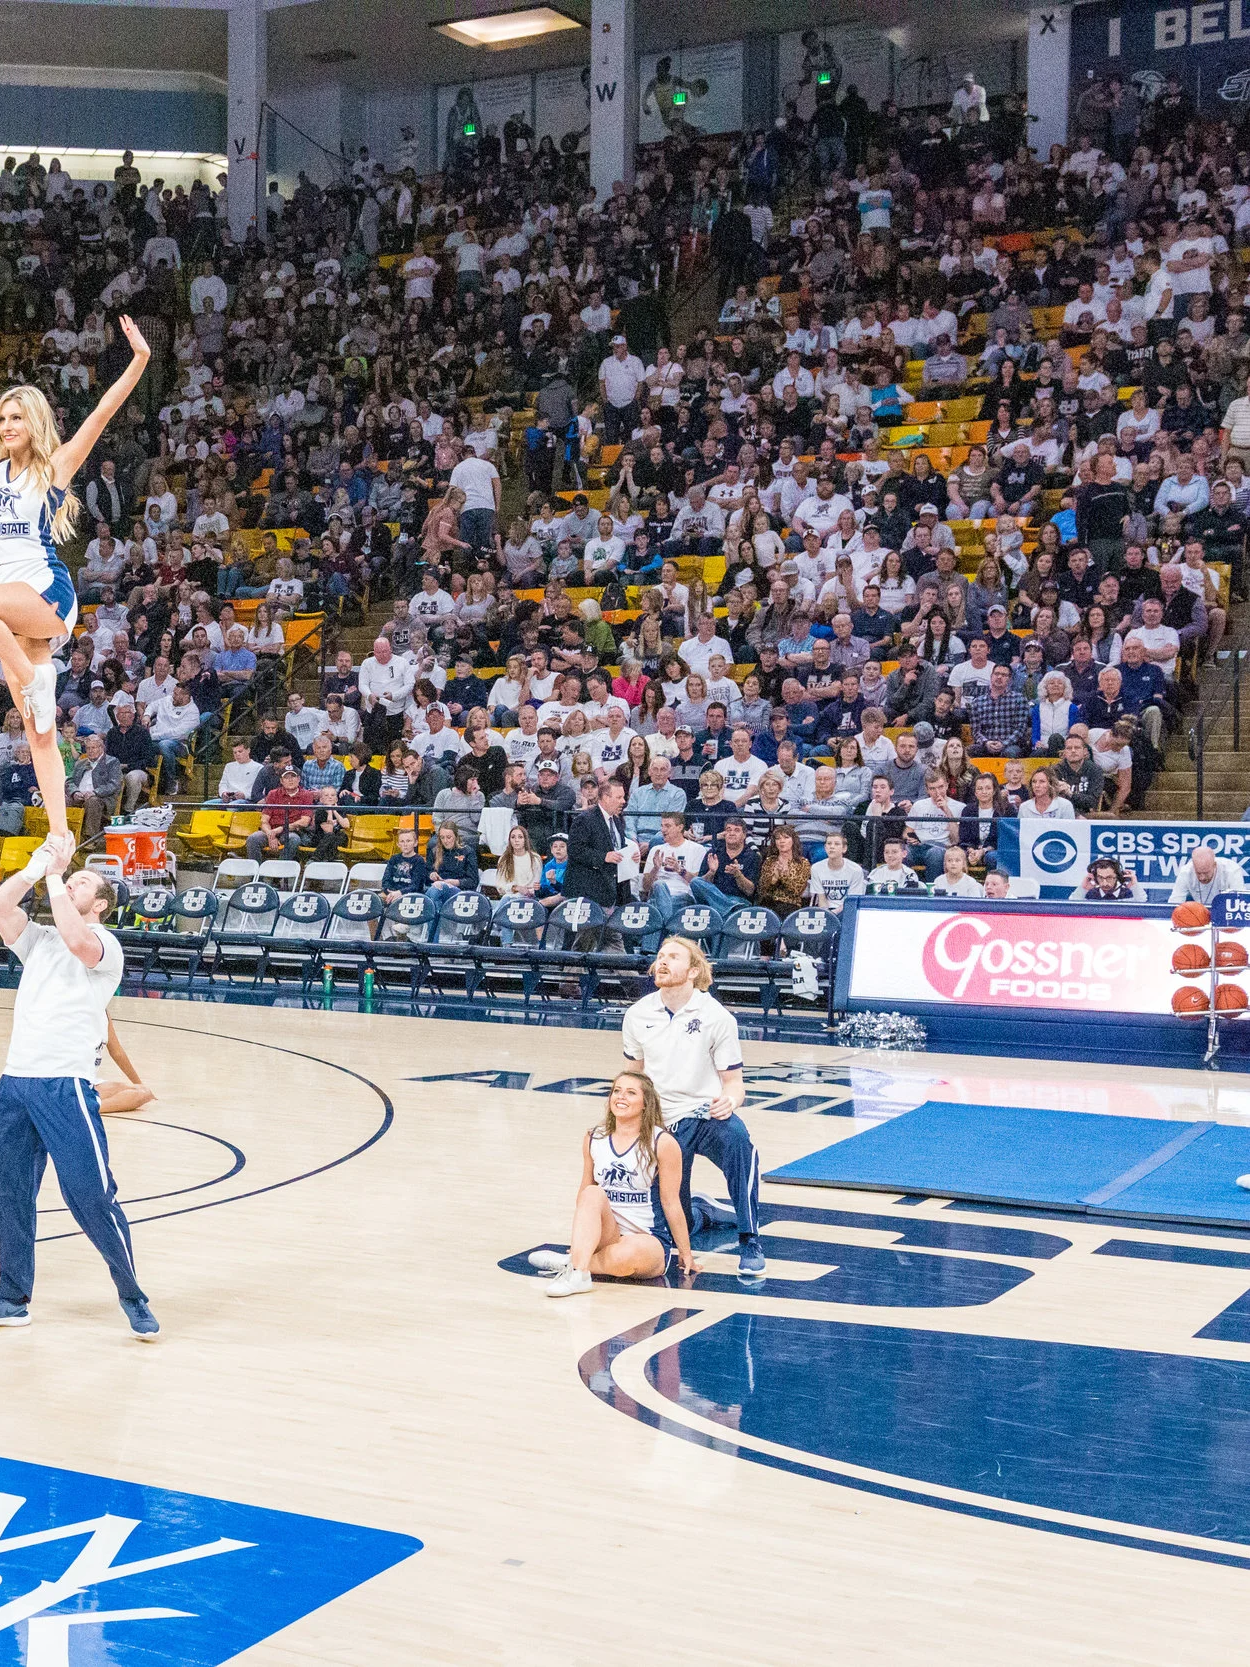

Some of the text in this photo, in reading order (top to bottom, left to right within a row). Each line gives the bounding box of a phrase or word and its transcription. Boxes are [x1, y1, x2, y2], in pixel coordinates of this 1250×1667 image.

[1040, 14, 1056, 35] X
[595, 82, 617, 103] W
[234, 138, 245, 155] V
[2, 522, 29, 535] STATE
[1096, 832, 1155, 854] CBS
[934, 916, 1150, 998] Gossner
[989, 978, 1112, 1001] FOODS
[619, 1192, 648, 1203] STATE
